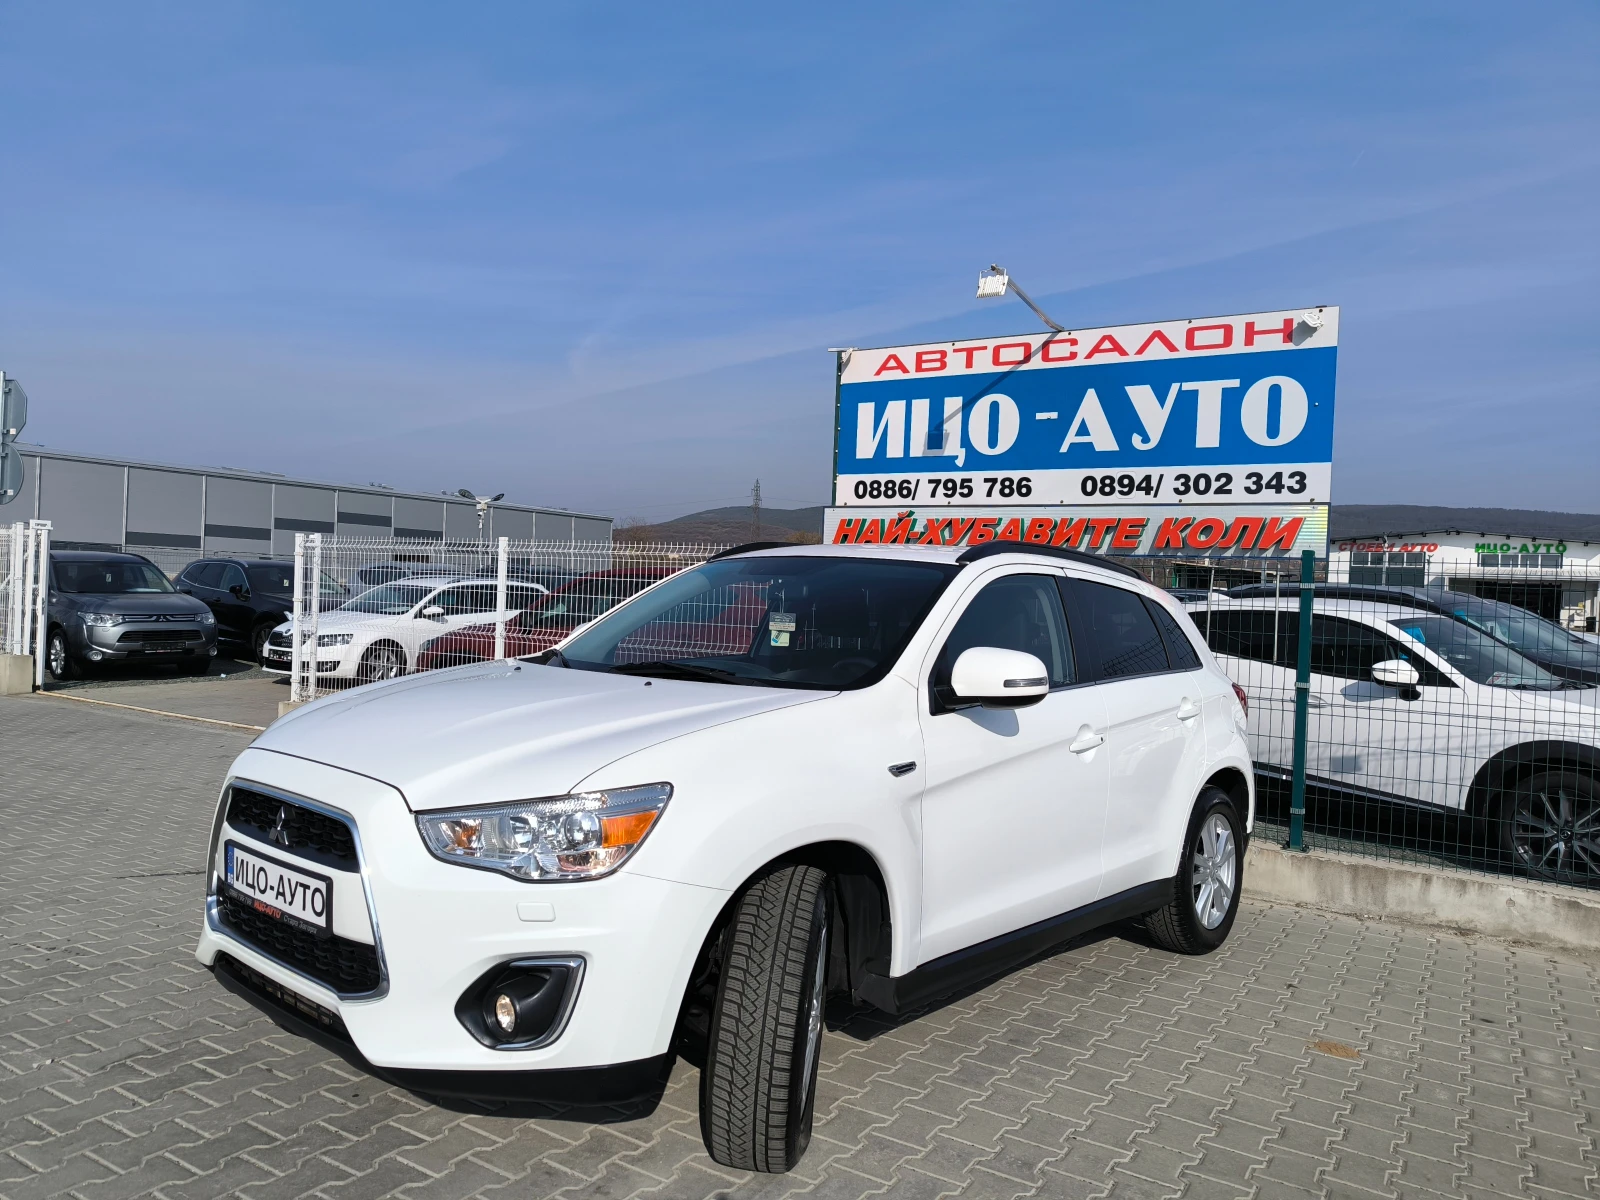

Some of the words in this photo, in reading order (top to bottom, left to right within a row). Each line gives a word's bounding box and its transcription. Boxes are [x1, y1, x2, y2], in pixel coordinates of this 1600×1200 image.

[873, 318, 1294, 376] АВТОСАЛОН
[853, 478, 921, 500] 0886/
[927, 478, 974, 498] 795
[983, 476, 1032, 498] 786
[1080, 474, 1163, 499] 0894/
[1172, 472, 1233, 495] 302
[1244, 471, 1308, 494] 343
[832, 510, 1149, 548] НАЙ-ХУБАВИТЕ
[1153, 516, 1306, 550] КОЛИ
[1399, 542, 1439, 553] АУТО
[1474, 542, 1568, 554] ИЦО-АУТО
[235, 856, 325, 917] ИЦО-АУТО
